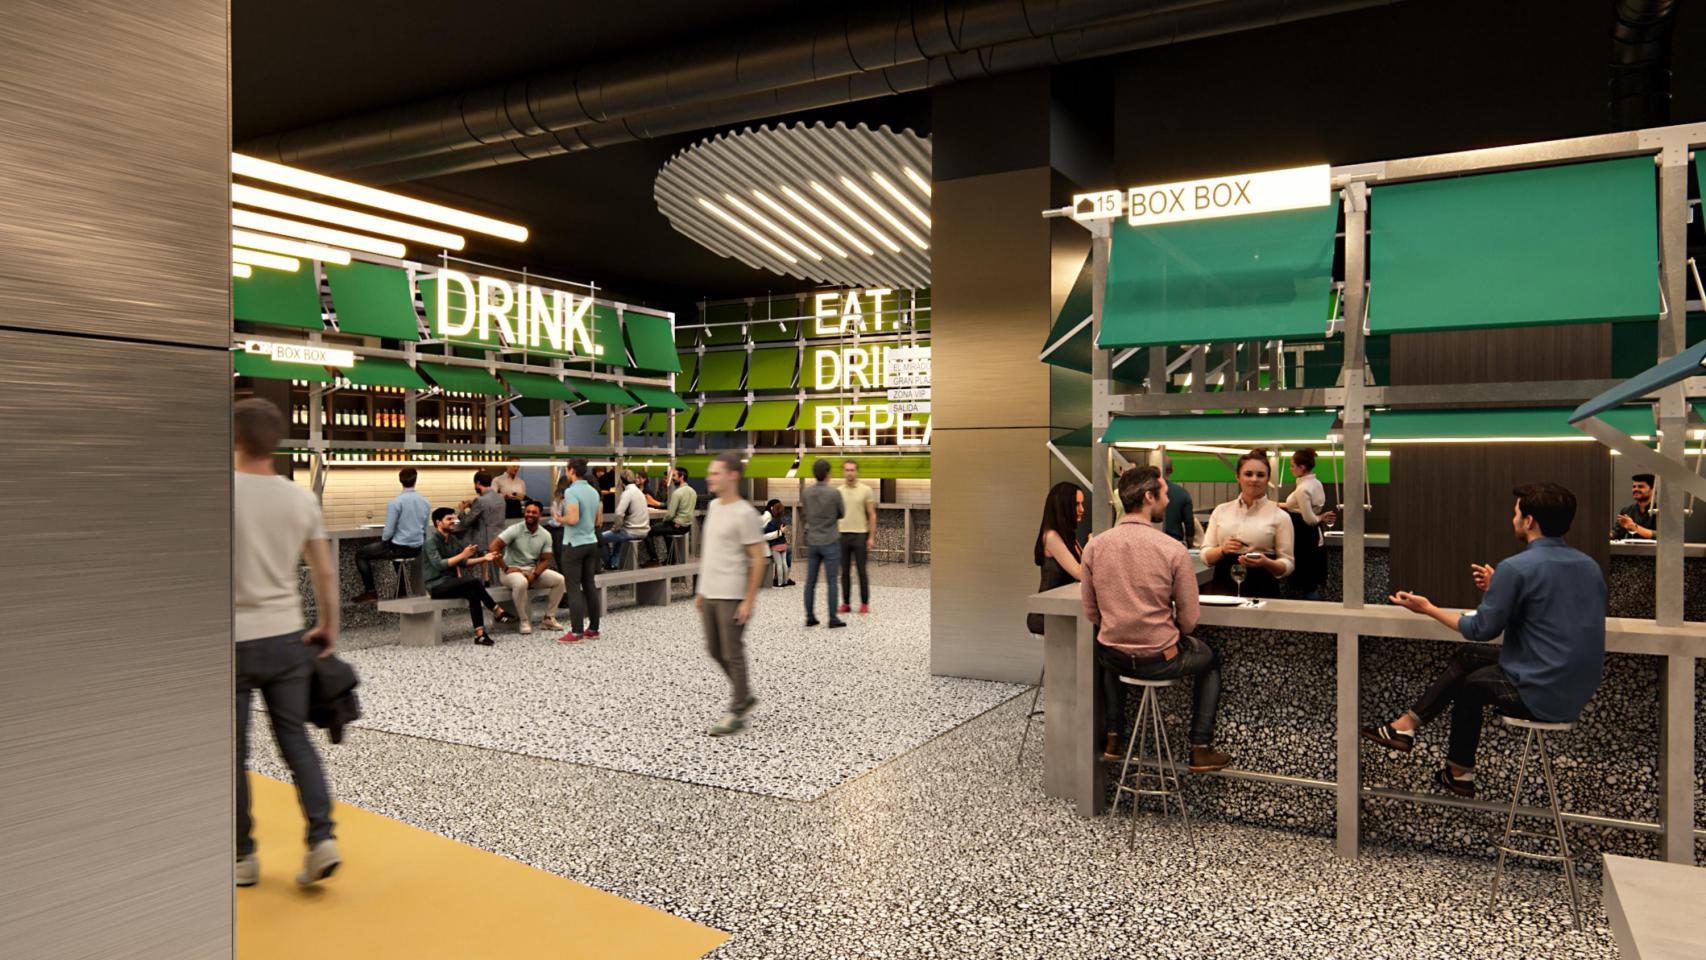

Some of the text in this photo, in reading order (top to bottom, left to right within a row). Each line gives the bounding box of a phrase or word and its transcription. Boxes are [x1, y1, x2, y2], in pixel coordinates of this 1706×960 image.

[1097, 194, 1115, 212] 15
[1132, 180, 1251, 217] BOX BOX
[437, 268, 604, 356] DRINK.
[815, 288, 900, 335] EAT.
[277, 345, 301, 360] BOX
[303, 348, 327, 362] BOX
[893, 376, 913, 385] GRAN
[893, 389, 926, 399] ZONA VIP
[893, 403, 918, 413] SALIDA
